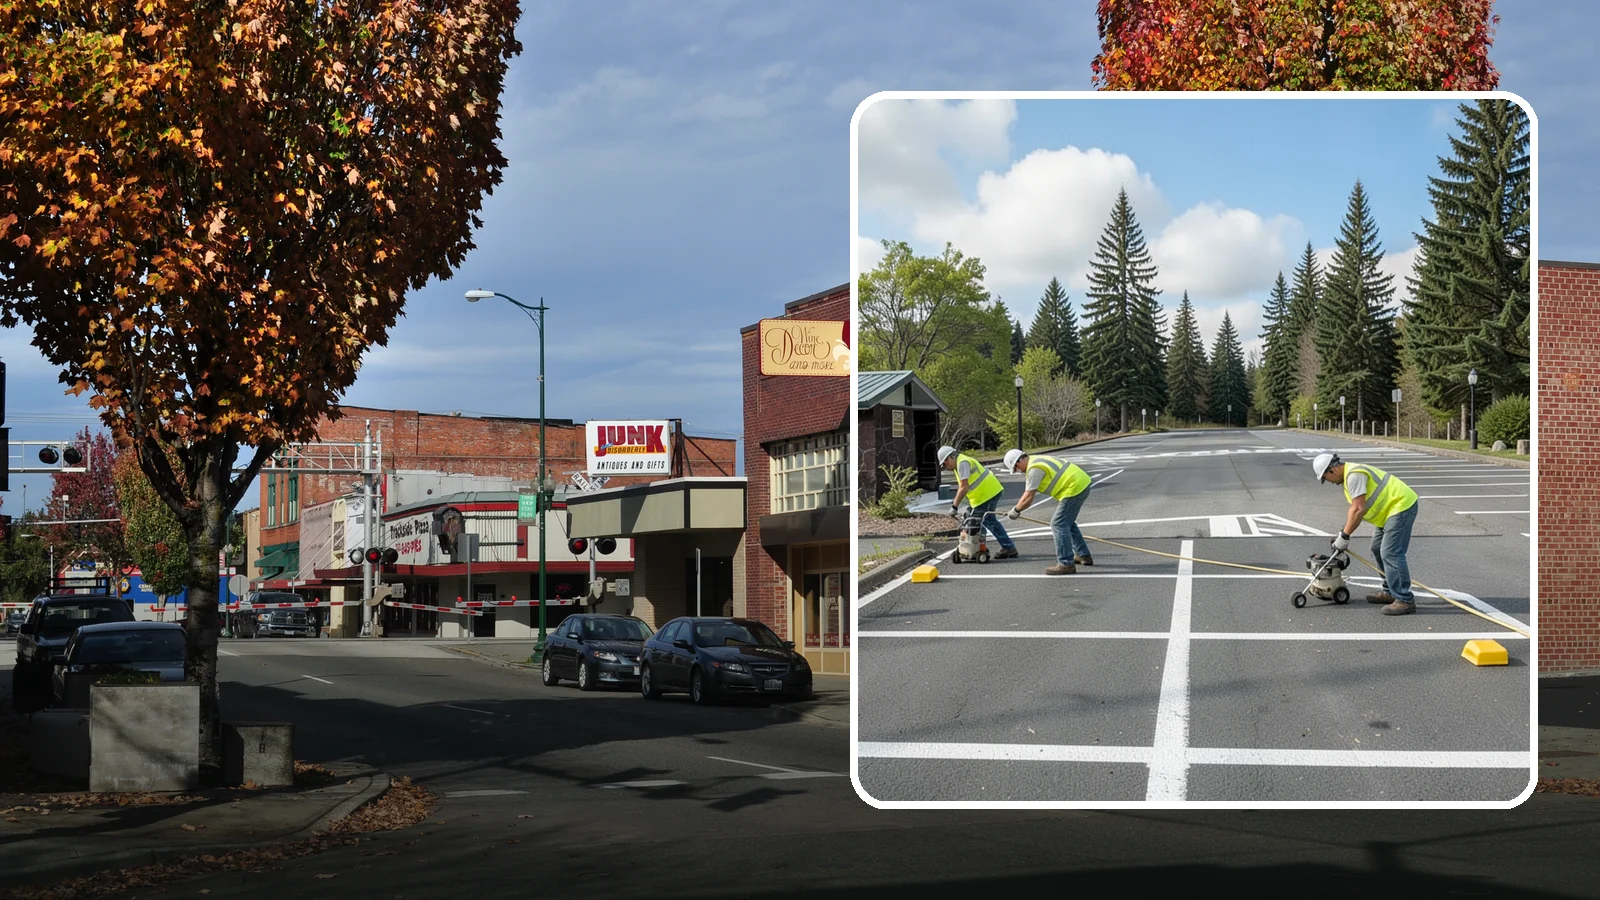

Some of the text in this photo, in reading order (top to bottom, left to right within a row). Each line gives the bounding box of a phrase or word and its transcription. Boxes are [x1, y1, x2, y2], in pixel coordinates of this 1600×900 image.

[765, 328, 830, 365] Decor
[595, 425, 665, 457] JUNK
[597, 460, 665, 470] ANTIQUES AND GIFTS
[390, 519, 429, 539] Trackside Pizza
